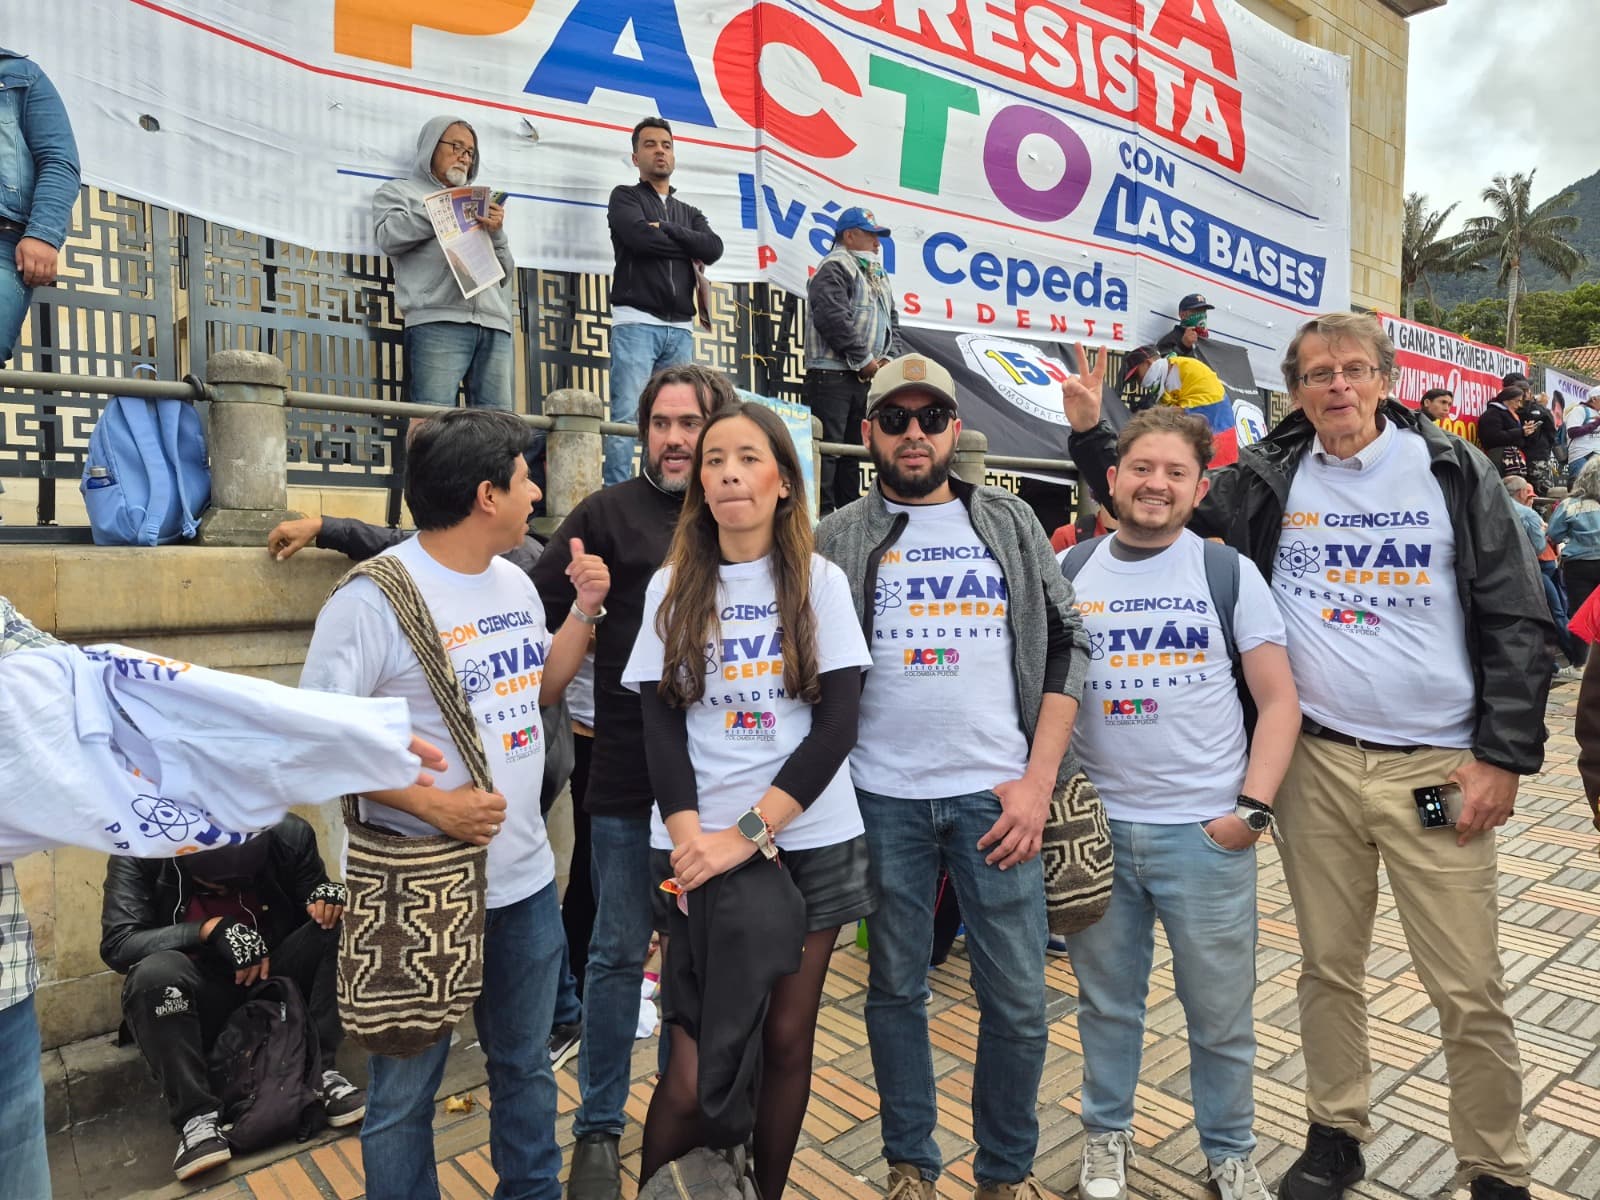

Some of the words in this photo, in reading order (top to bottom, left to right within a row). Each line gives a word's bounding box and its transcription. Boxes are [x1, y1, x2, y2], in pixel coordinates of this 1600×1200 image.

[833, 0, 1234, 161] RESISTA
[1119, 141, 1175, 188] CON
[1116, 187, 1196, 254] LAS
[1209, 223, 1315, 299] BASES
[922, 231, 1128, 312] Cepeda
[758, 245, 1124, 341] PSIDENTE
[1400, 325, 1436, 357] GANAR
[1440, 336, 1453, 361] EN
[1281, 512, 1319, 527] CON
[1324, 511, 1430, 528] CIENCIAS
[880, 550, 901, 564] ON
[905, 546, 995, 562] CIENCIA
[1325, 538, 1431, 567] IVÁN
[906, 569, 1008, 600] IVÁN
[1326, 569, 1431, 585] CEPEDA
[720, 601, 779, 621] CIENC
[909, 601, 1005, 616] CEPEDA
[1109, 597, 1207, 614] CIENCIAS
[1322, 607, 1380, 625] PACTO
[440, 621, 478, 648] CON
[477, 610, 534, 635] CIENCIAS
[875, 627, 1001, 640] RESIDENTE
[1109, 621, 1209, 652] IVÁN
[720, 627, 784, 662] IVÁ
[903, 648, 960, 665] PACTO
[1109, 652, 1206, 668] CEPEDA
[724, 660, 784, 680] CEPE
[495, 670, 543, 697] CEPE
[1084, 673, 1207, 690] ESIDENTE
[702, 688, 785, 705] ESIDEN
[1103, 698, 1158, 715] PACTO
[485, 701, 537, 724] ESIDE
[725, 711, 776, 729] PACTO
